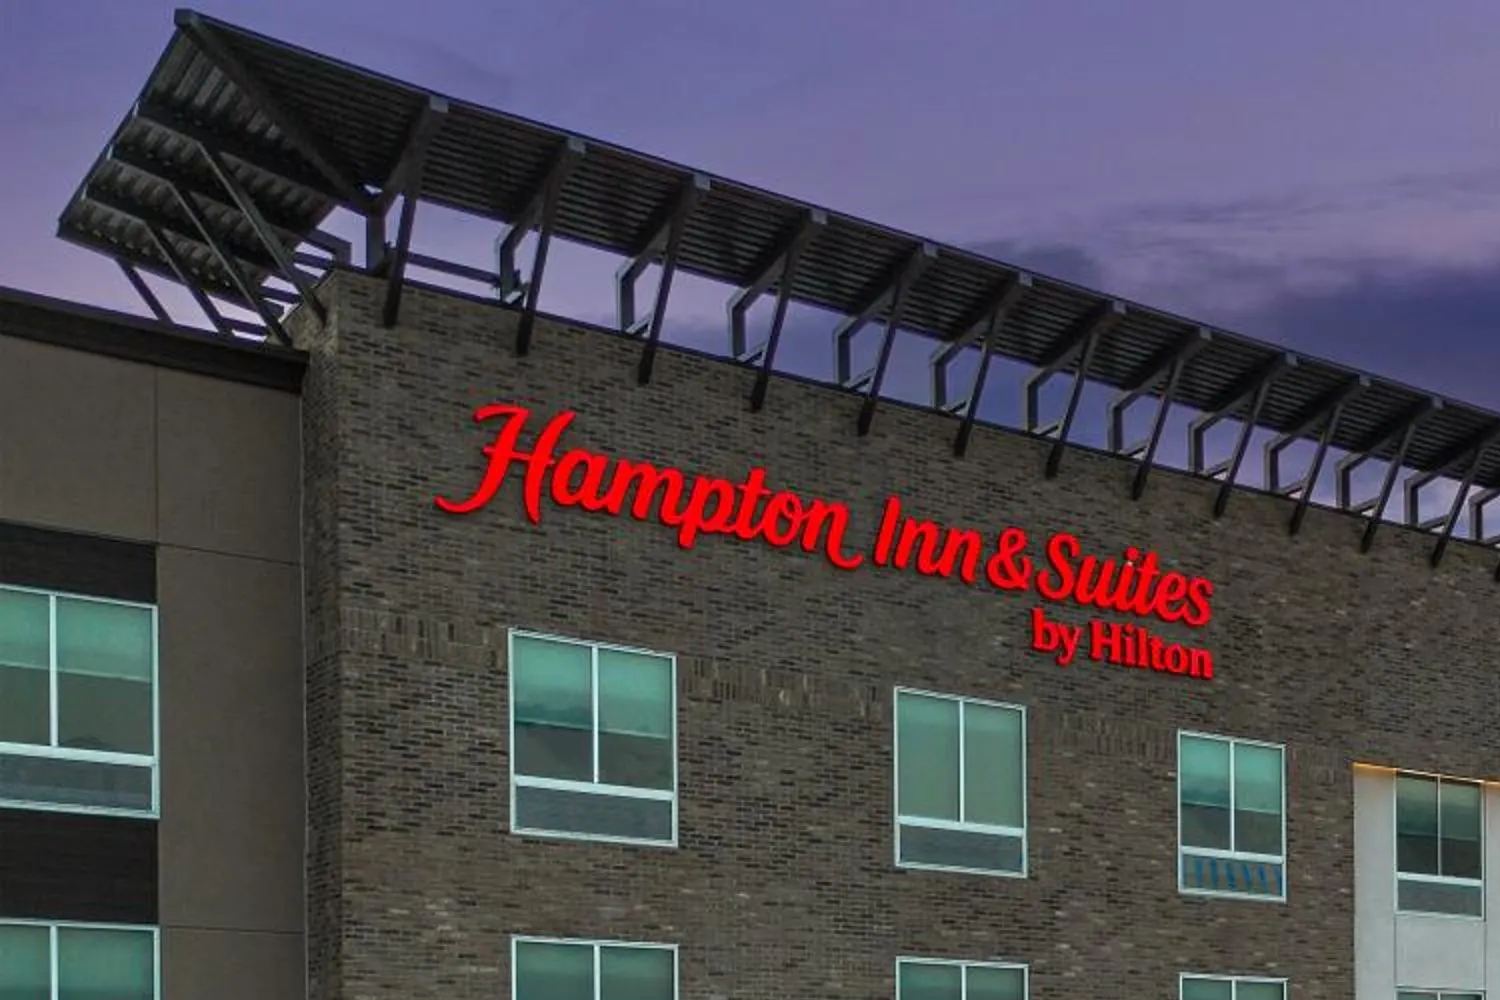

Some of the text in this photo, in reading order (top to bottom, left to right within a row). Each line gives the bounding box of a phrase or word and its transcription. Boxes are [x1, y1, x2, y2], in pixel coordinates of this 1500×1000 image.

[434, 403, 1214, 627] Hampton Inn & Suites
[1032, 606, 1214, 680] by Hilton
